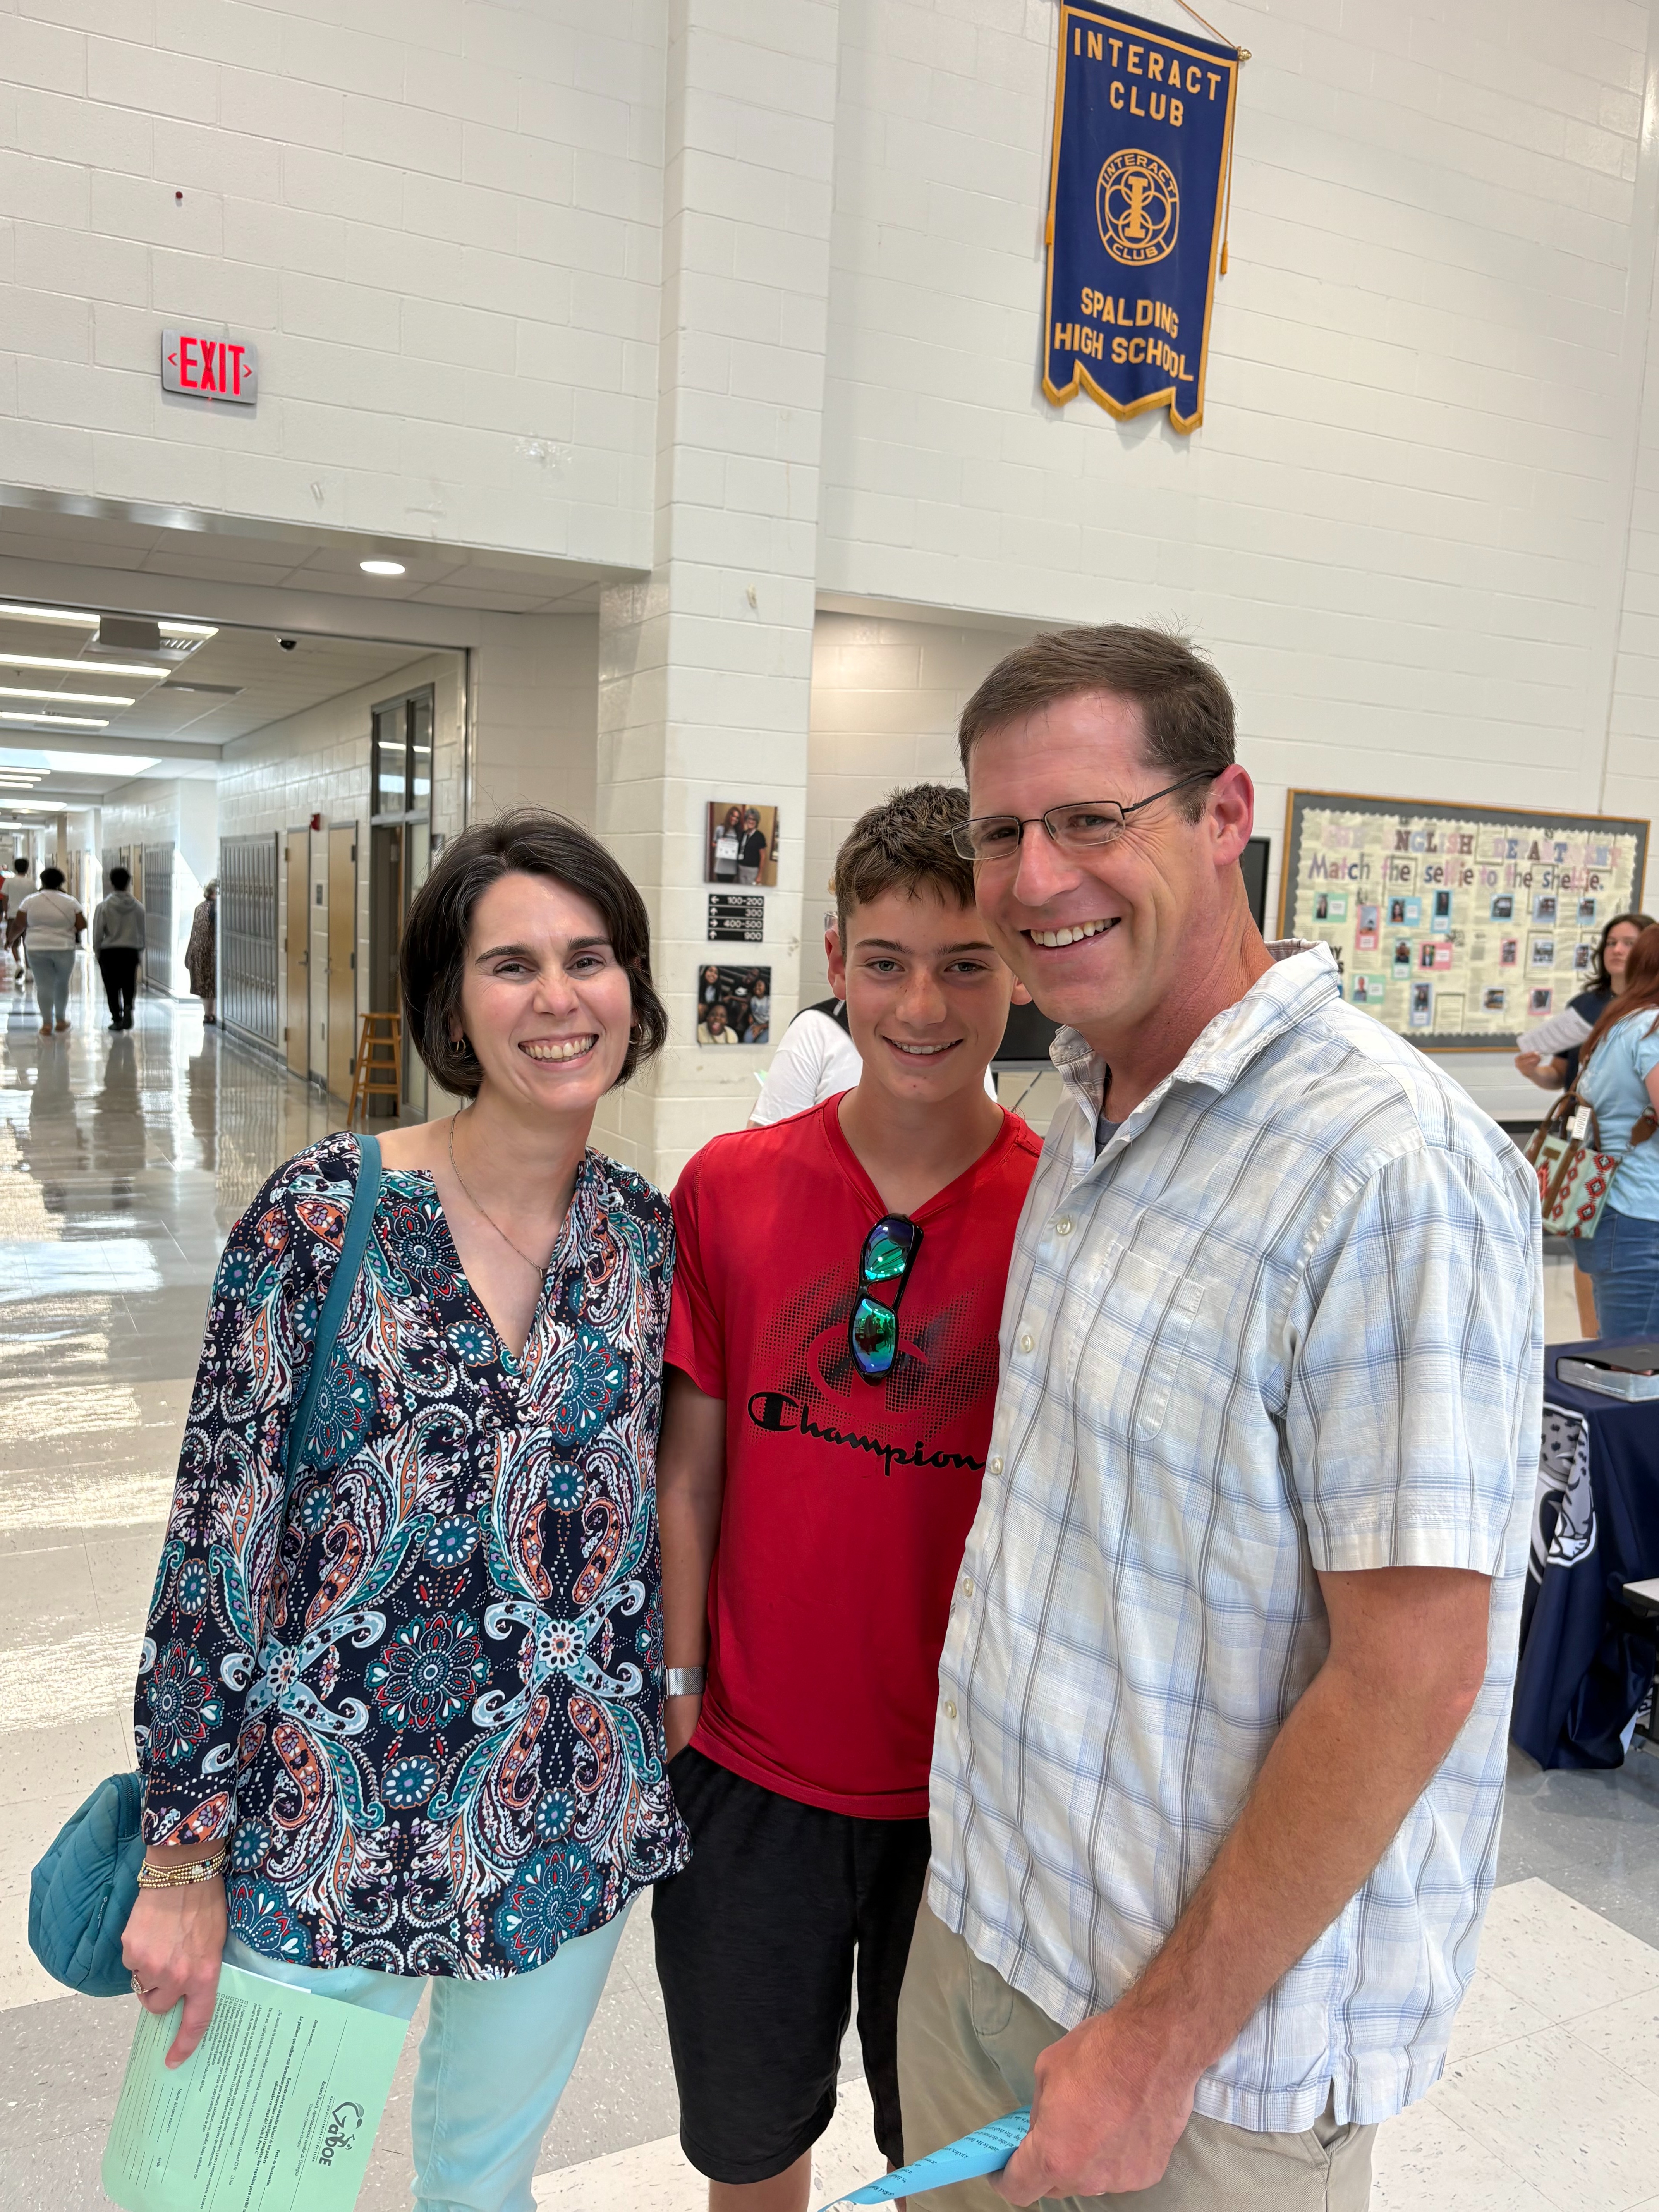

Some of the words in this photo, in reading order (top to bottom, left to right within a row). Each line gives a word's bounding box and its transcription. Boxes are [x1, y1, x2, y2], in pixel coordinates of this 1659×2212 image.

[1074, 28, 1221, 101] INTERACT
[1110, 81, 1184, 127] CLUB
[1105, 154, 1176, 193] INTERACT
[1112, 244, 1158, 260] CLUB
[1080, 287, 1179, 339] SPALDING
[180, 336, 245, 396] EXIT
[1054, 323, 1104, 360] HIGH
[1111, 337, 1194, 381] SCHOOL
[1382, 827, 1474, 854] NGLISH
[1494, 838, 1622, 867] DEATENT
[1308, 852, 1370, 880] Match
[1381, 857, 1410, 882] the
[1424, 860, 1474, 887] selfie
[1480, 866, 1498, 887] to
[1506, 863, 1533, 888] the
[727, 896, 763, 905] 100-200
[745, 909, 762, 917] 300
[723, 919, 762, 928] 400-500
[744, 931, 761, 940] 900
[748, 1391, 986, 1477] Champion
[319, 2112, 329, 2135] Department
[312, 2142, 320, 2162] Education
